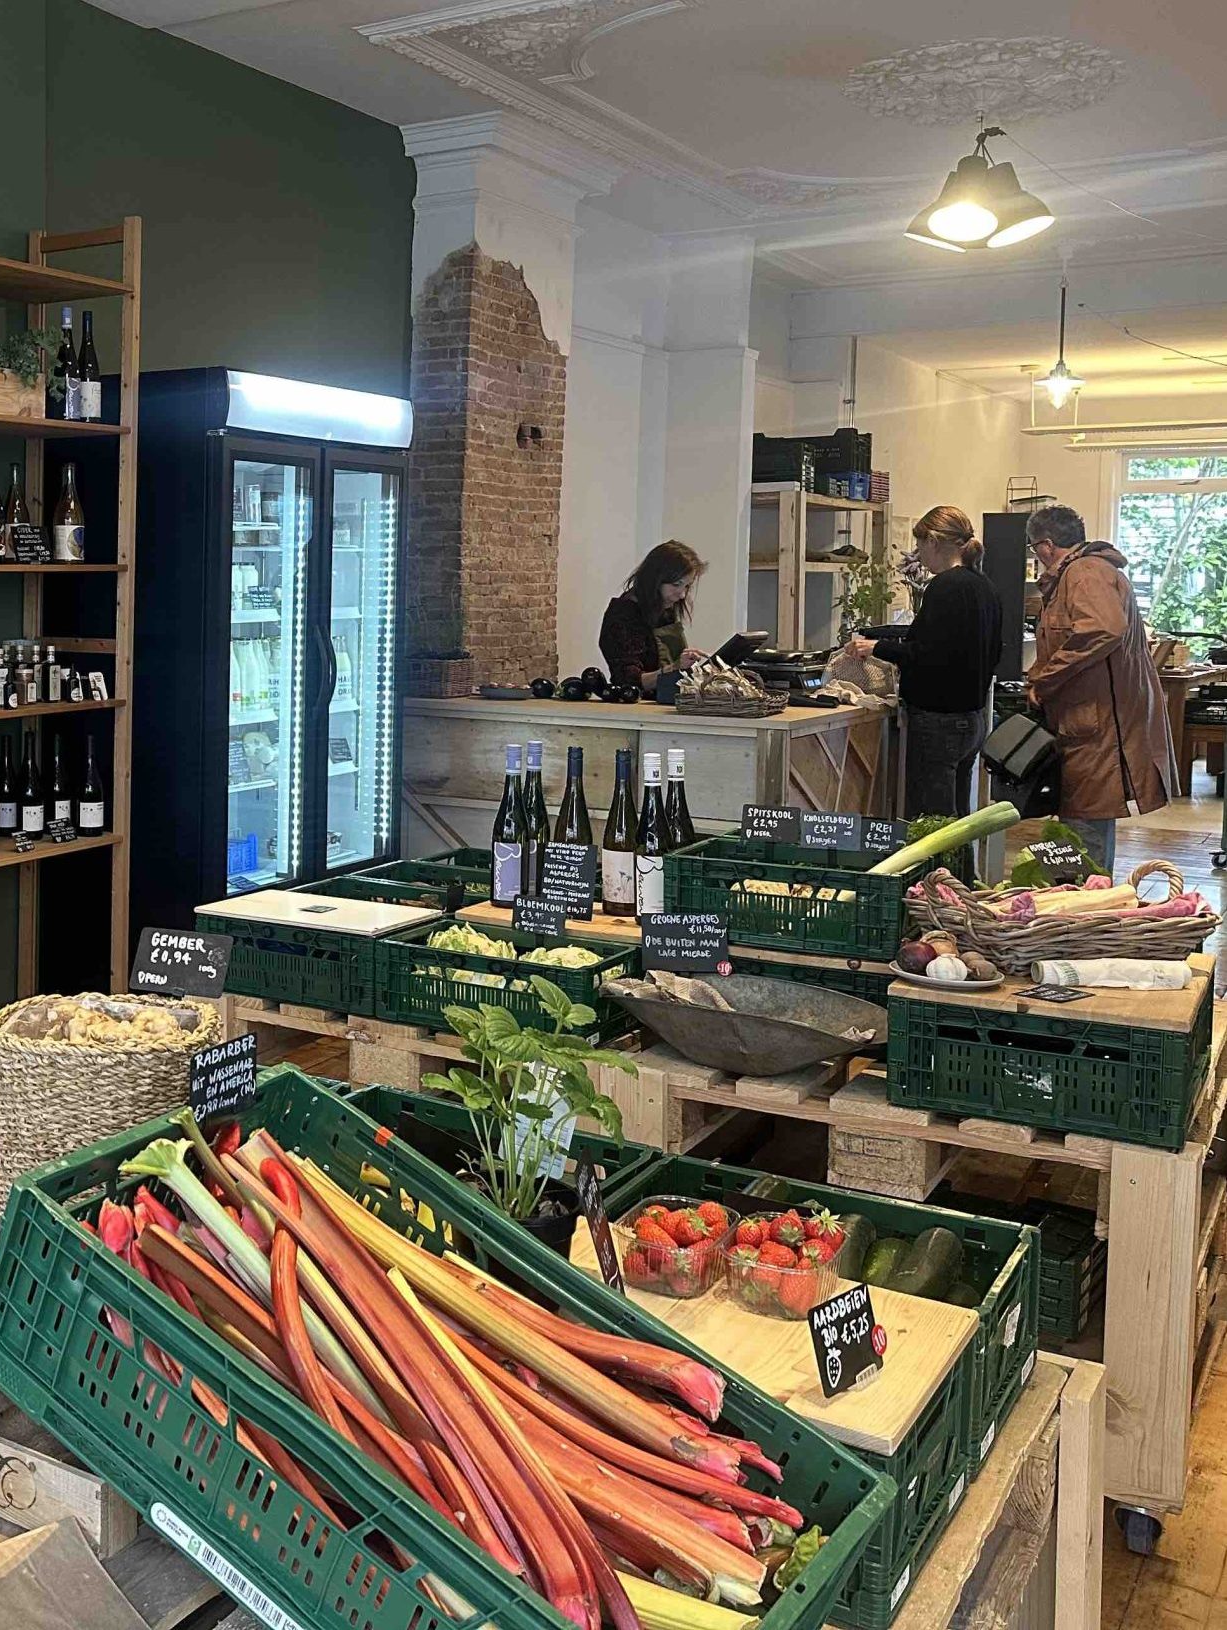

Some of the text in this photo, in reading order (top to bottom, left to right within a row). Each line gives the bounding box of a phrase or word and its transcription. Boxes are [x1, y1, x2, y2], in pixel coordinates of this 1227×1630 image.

[747, 807, 793, 820] SPITSKOOL
[869, 822, 893, 834] PREI
[517, 898, 565, 913] BLOEMKOOL
[651, 914, 719, 925] GROENE ASPERGES
[151, 932, 206, 953] GEMBER
[652, 938, 719, 948] DE BUITEN MAN
[145, 972, 168, 985] PERU
[194, 1035, 256, 1070] RABARBER
[192, 1058, 254, 1092] UIT WASSENAAR
[206, 1070, 253, 1099] EN AMERICA
[814, 1286, 867, 1330] AARDBEIEN
[821, 1312, 869, 1348] BIO €5,25
